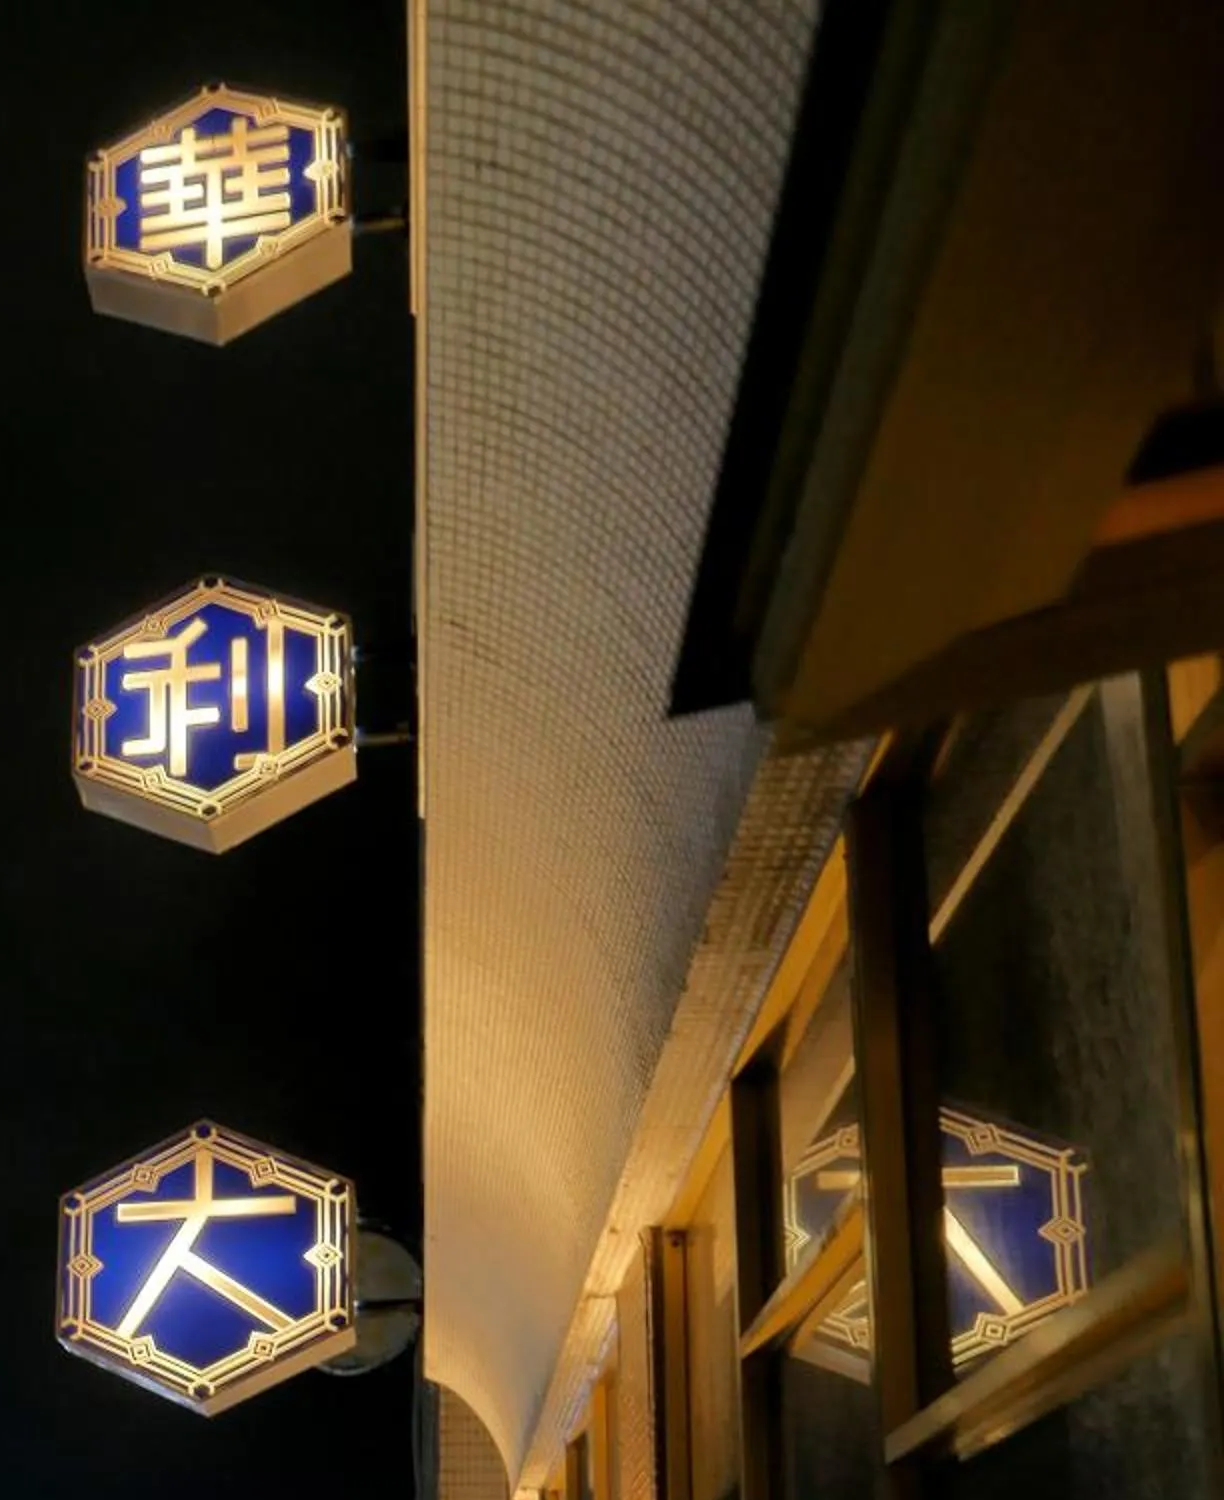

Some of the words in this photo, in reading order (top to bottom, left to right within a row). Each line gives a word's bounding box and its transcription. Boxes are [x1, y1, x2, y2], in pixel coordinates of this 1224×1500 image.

[140, 118, 290, 268] 華
[123, 618, 284, 776] 利
[116, 1147, 296, 1339] 大
